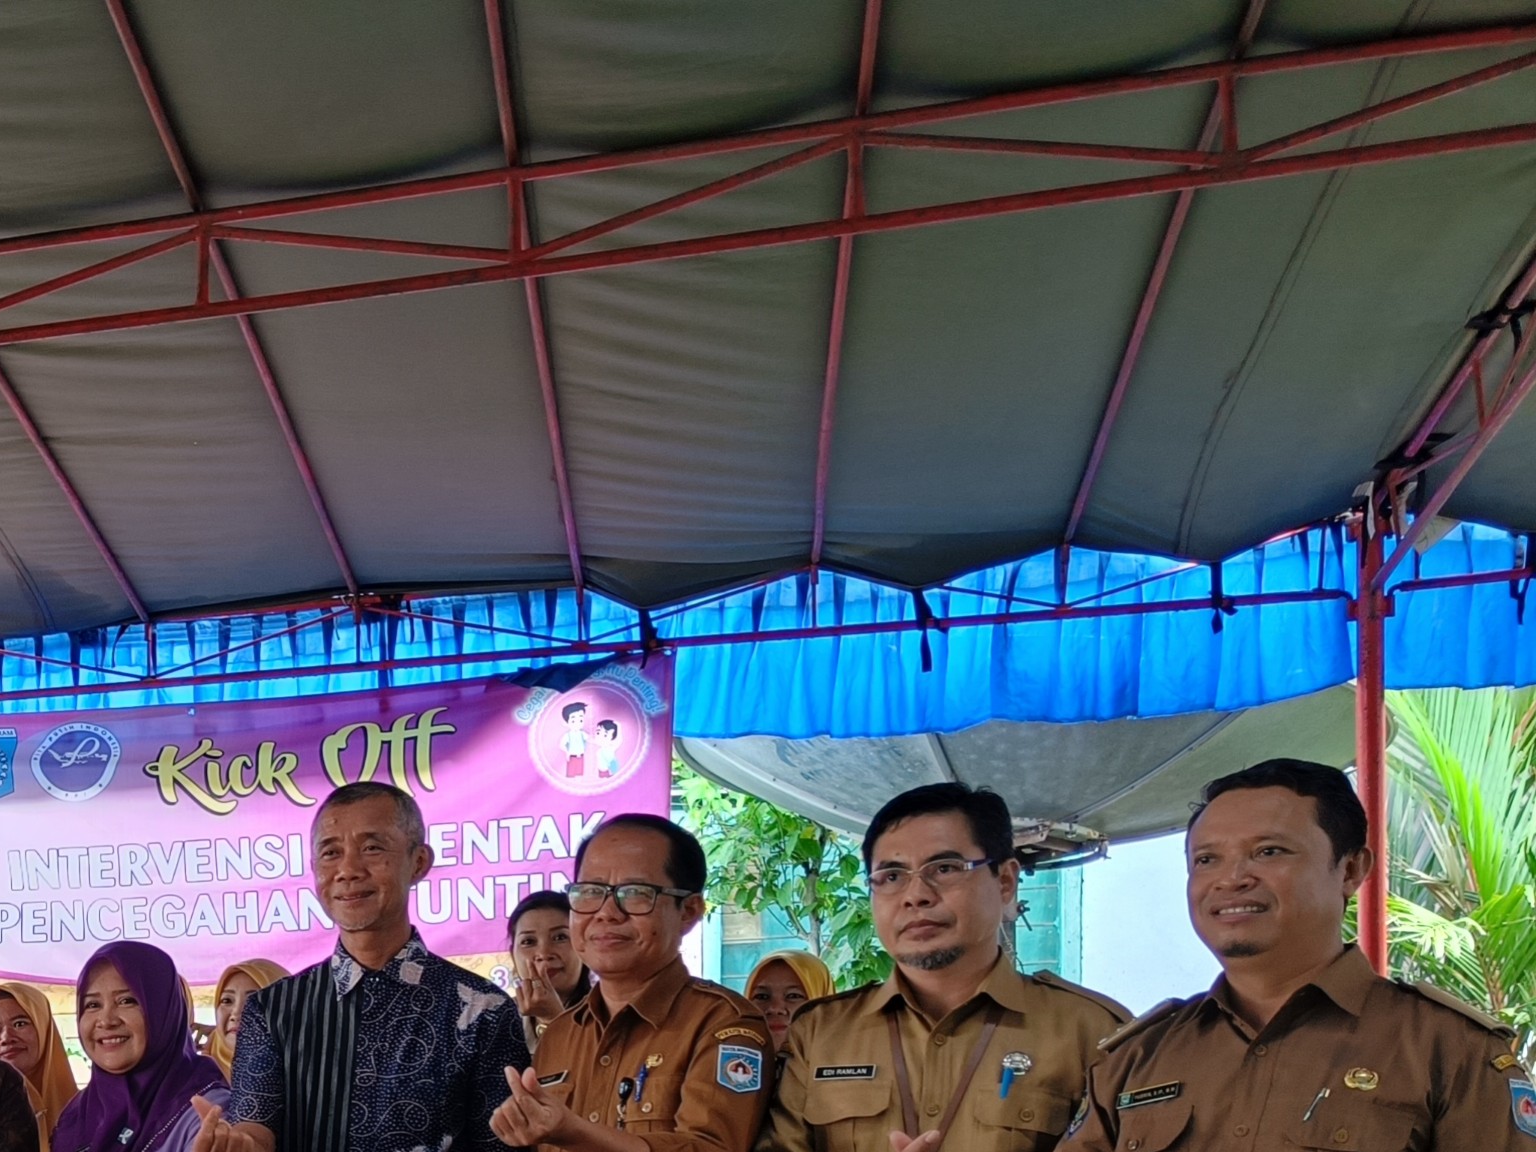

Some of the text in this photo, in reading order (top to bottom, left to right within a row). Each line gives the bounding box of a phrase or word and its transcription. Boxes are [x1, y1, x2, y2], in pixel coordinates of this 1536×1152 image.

[624, 665, 667, 713] Penting!
[143, 707, 456, 815] Kick Off
[7, 811, 606, 892] INTERVENSI ENTAK
